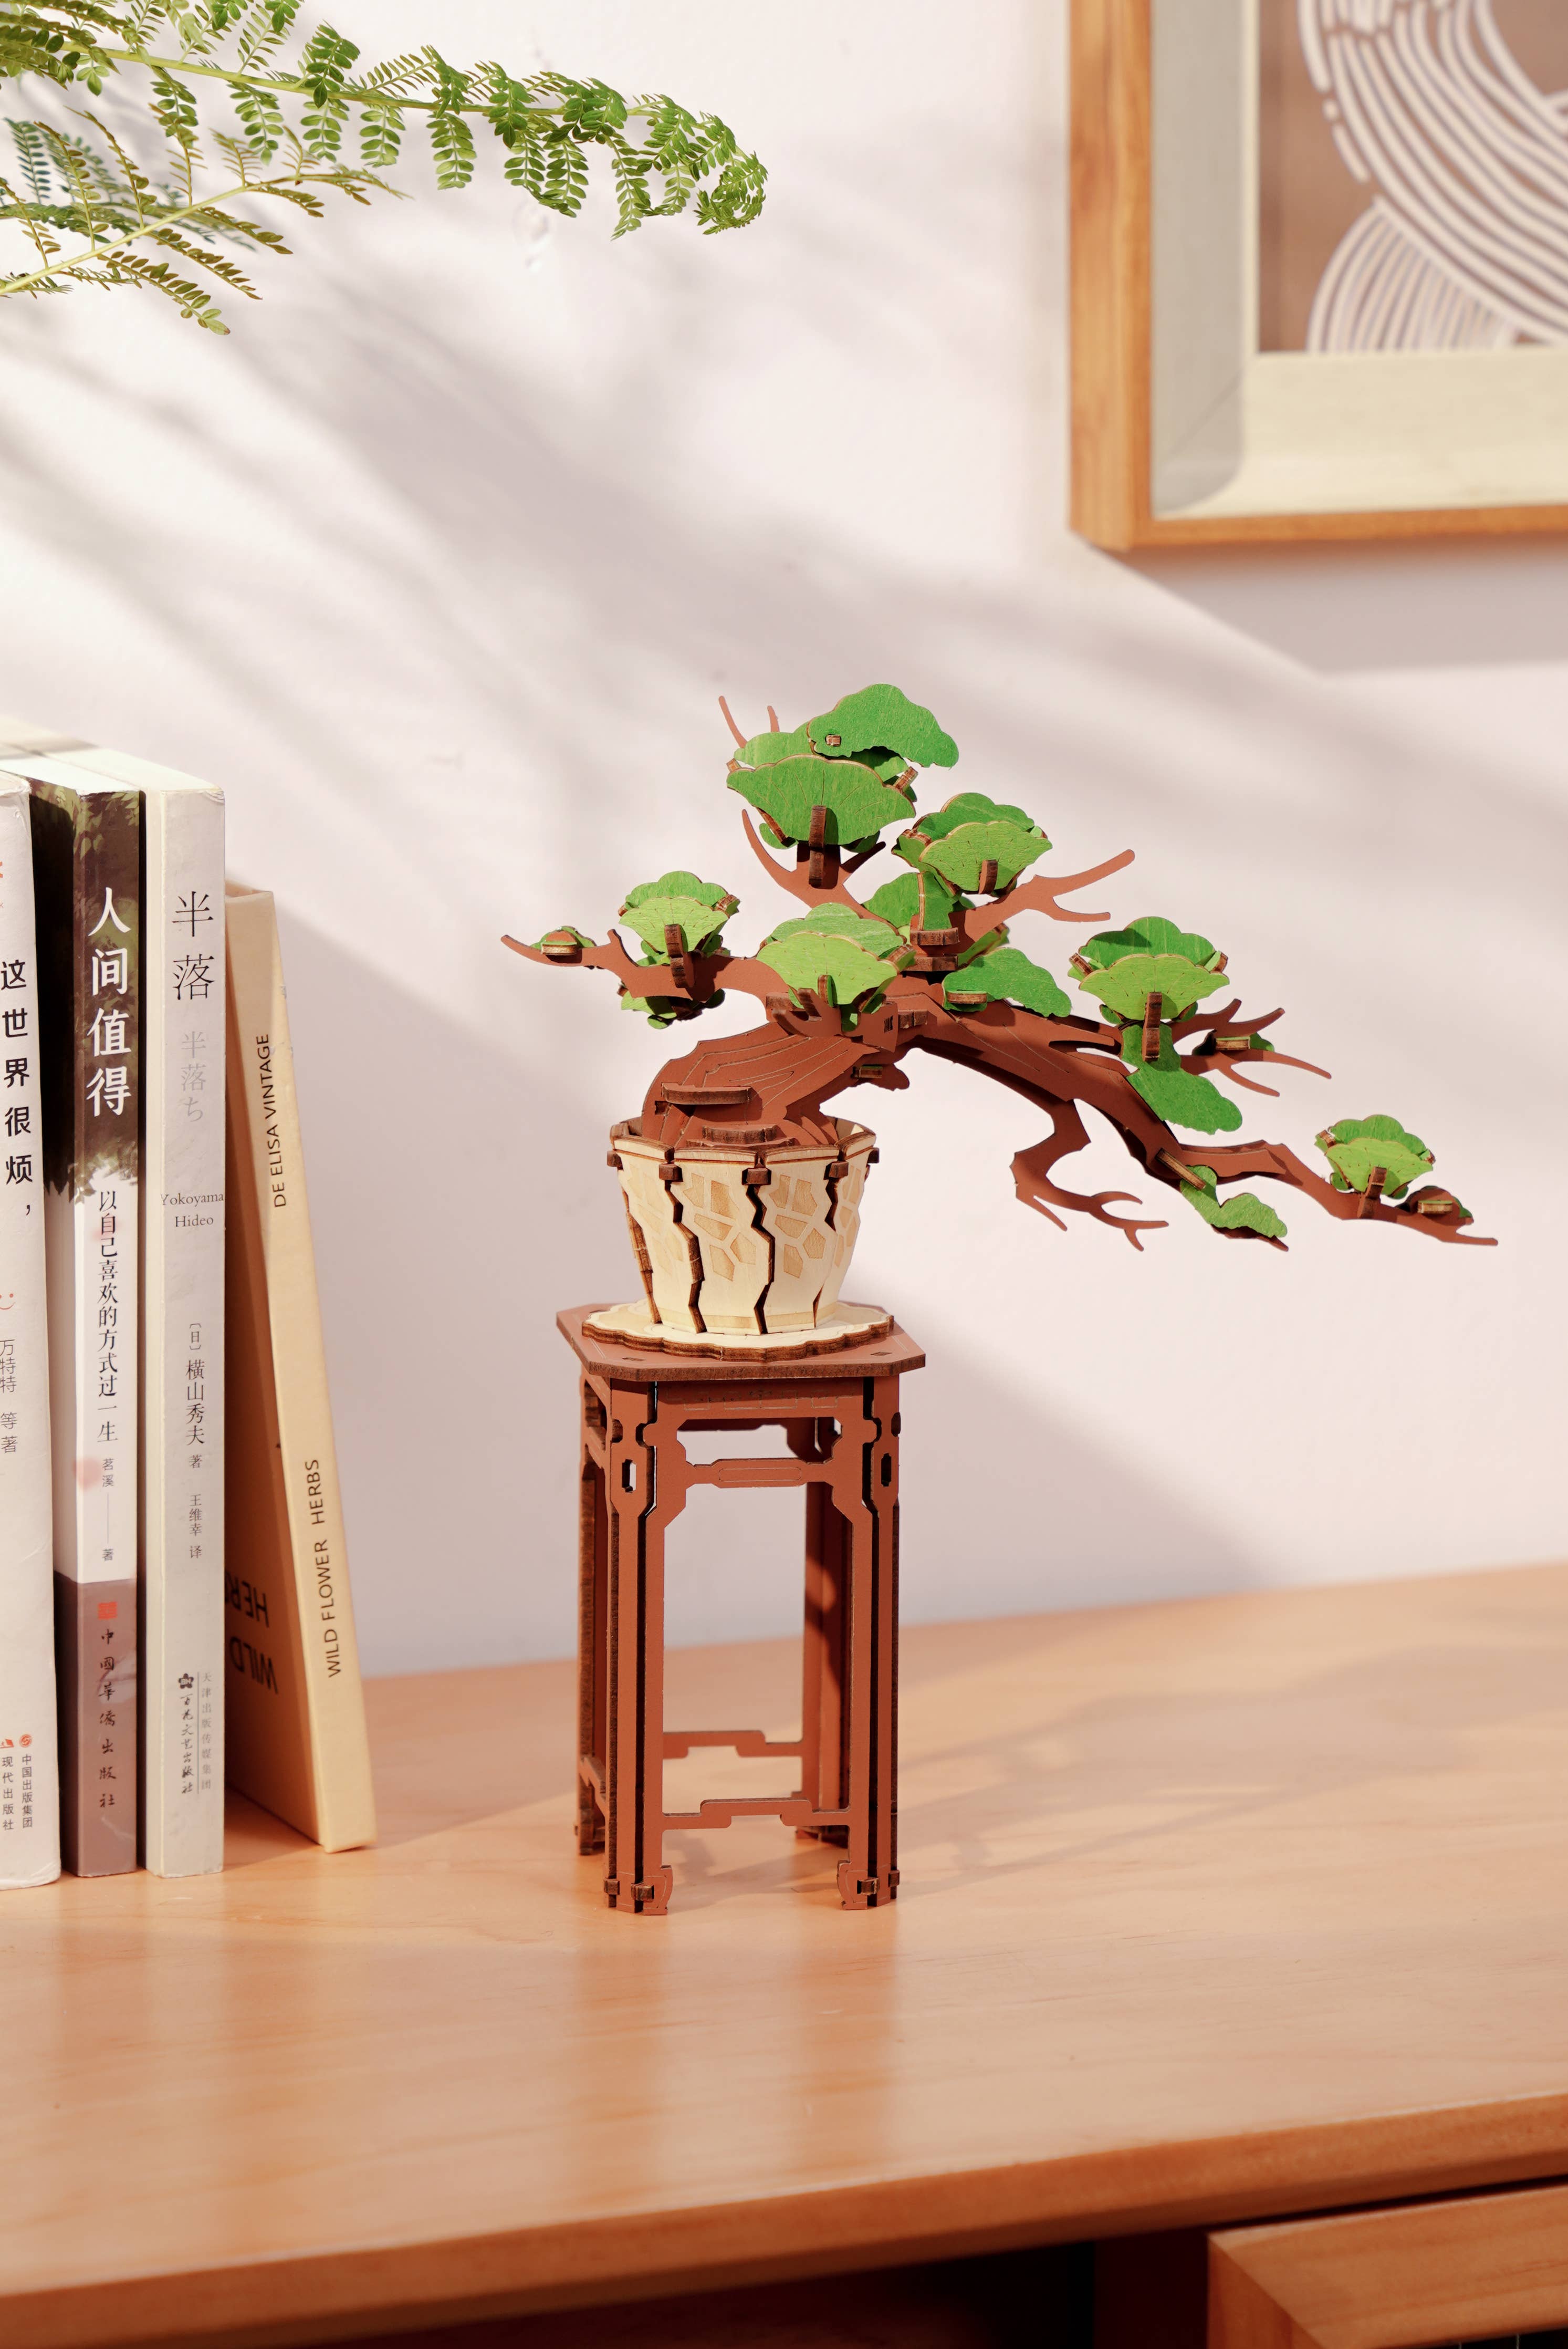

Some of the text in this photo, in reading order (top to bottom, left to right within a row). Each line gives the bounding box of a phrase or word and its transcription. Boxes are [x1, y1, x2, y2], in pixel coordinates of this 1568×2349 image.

[172, 891, 215, 1001] 半落
[87, 887, 132, 1117] 人间值得
[1, 959, 33, 1216] 这世界很烦，
[180, 1031, 206, 1122] 半落ち
[256, 1034, 287, 1208] DE ELISA VINTAGE
[160, 1192, 224, 1208] Yokoyama
[174, 1214, 214, 1228] Hideo
[97, 1190, 119, 1442] 以自己喜欢的方式过一生
[186, 1359, 205, 1446] 横山秀夫
[189, 1454, 202, 1469] 著
[189, 1494, 202, 1559] 王维幸 译
[305, 1459, 341, 1678] WILD FLOWER HERBS
[229, 1636, 278, 1694] WILD
[2, 1756, 14, 1831] 现代出版社
[22, 1754, 33, 1828] 中国出版集团
